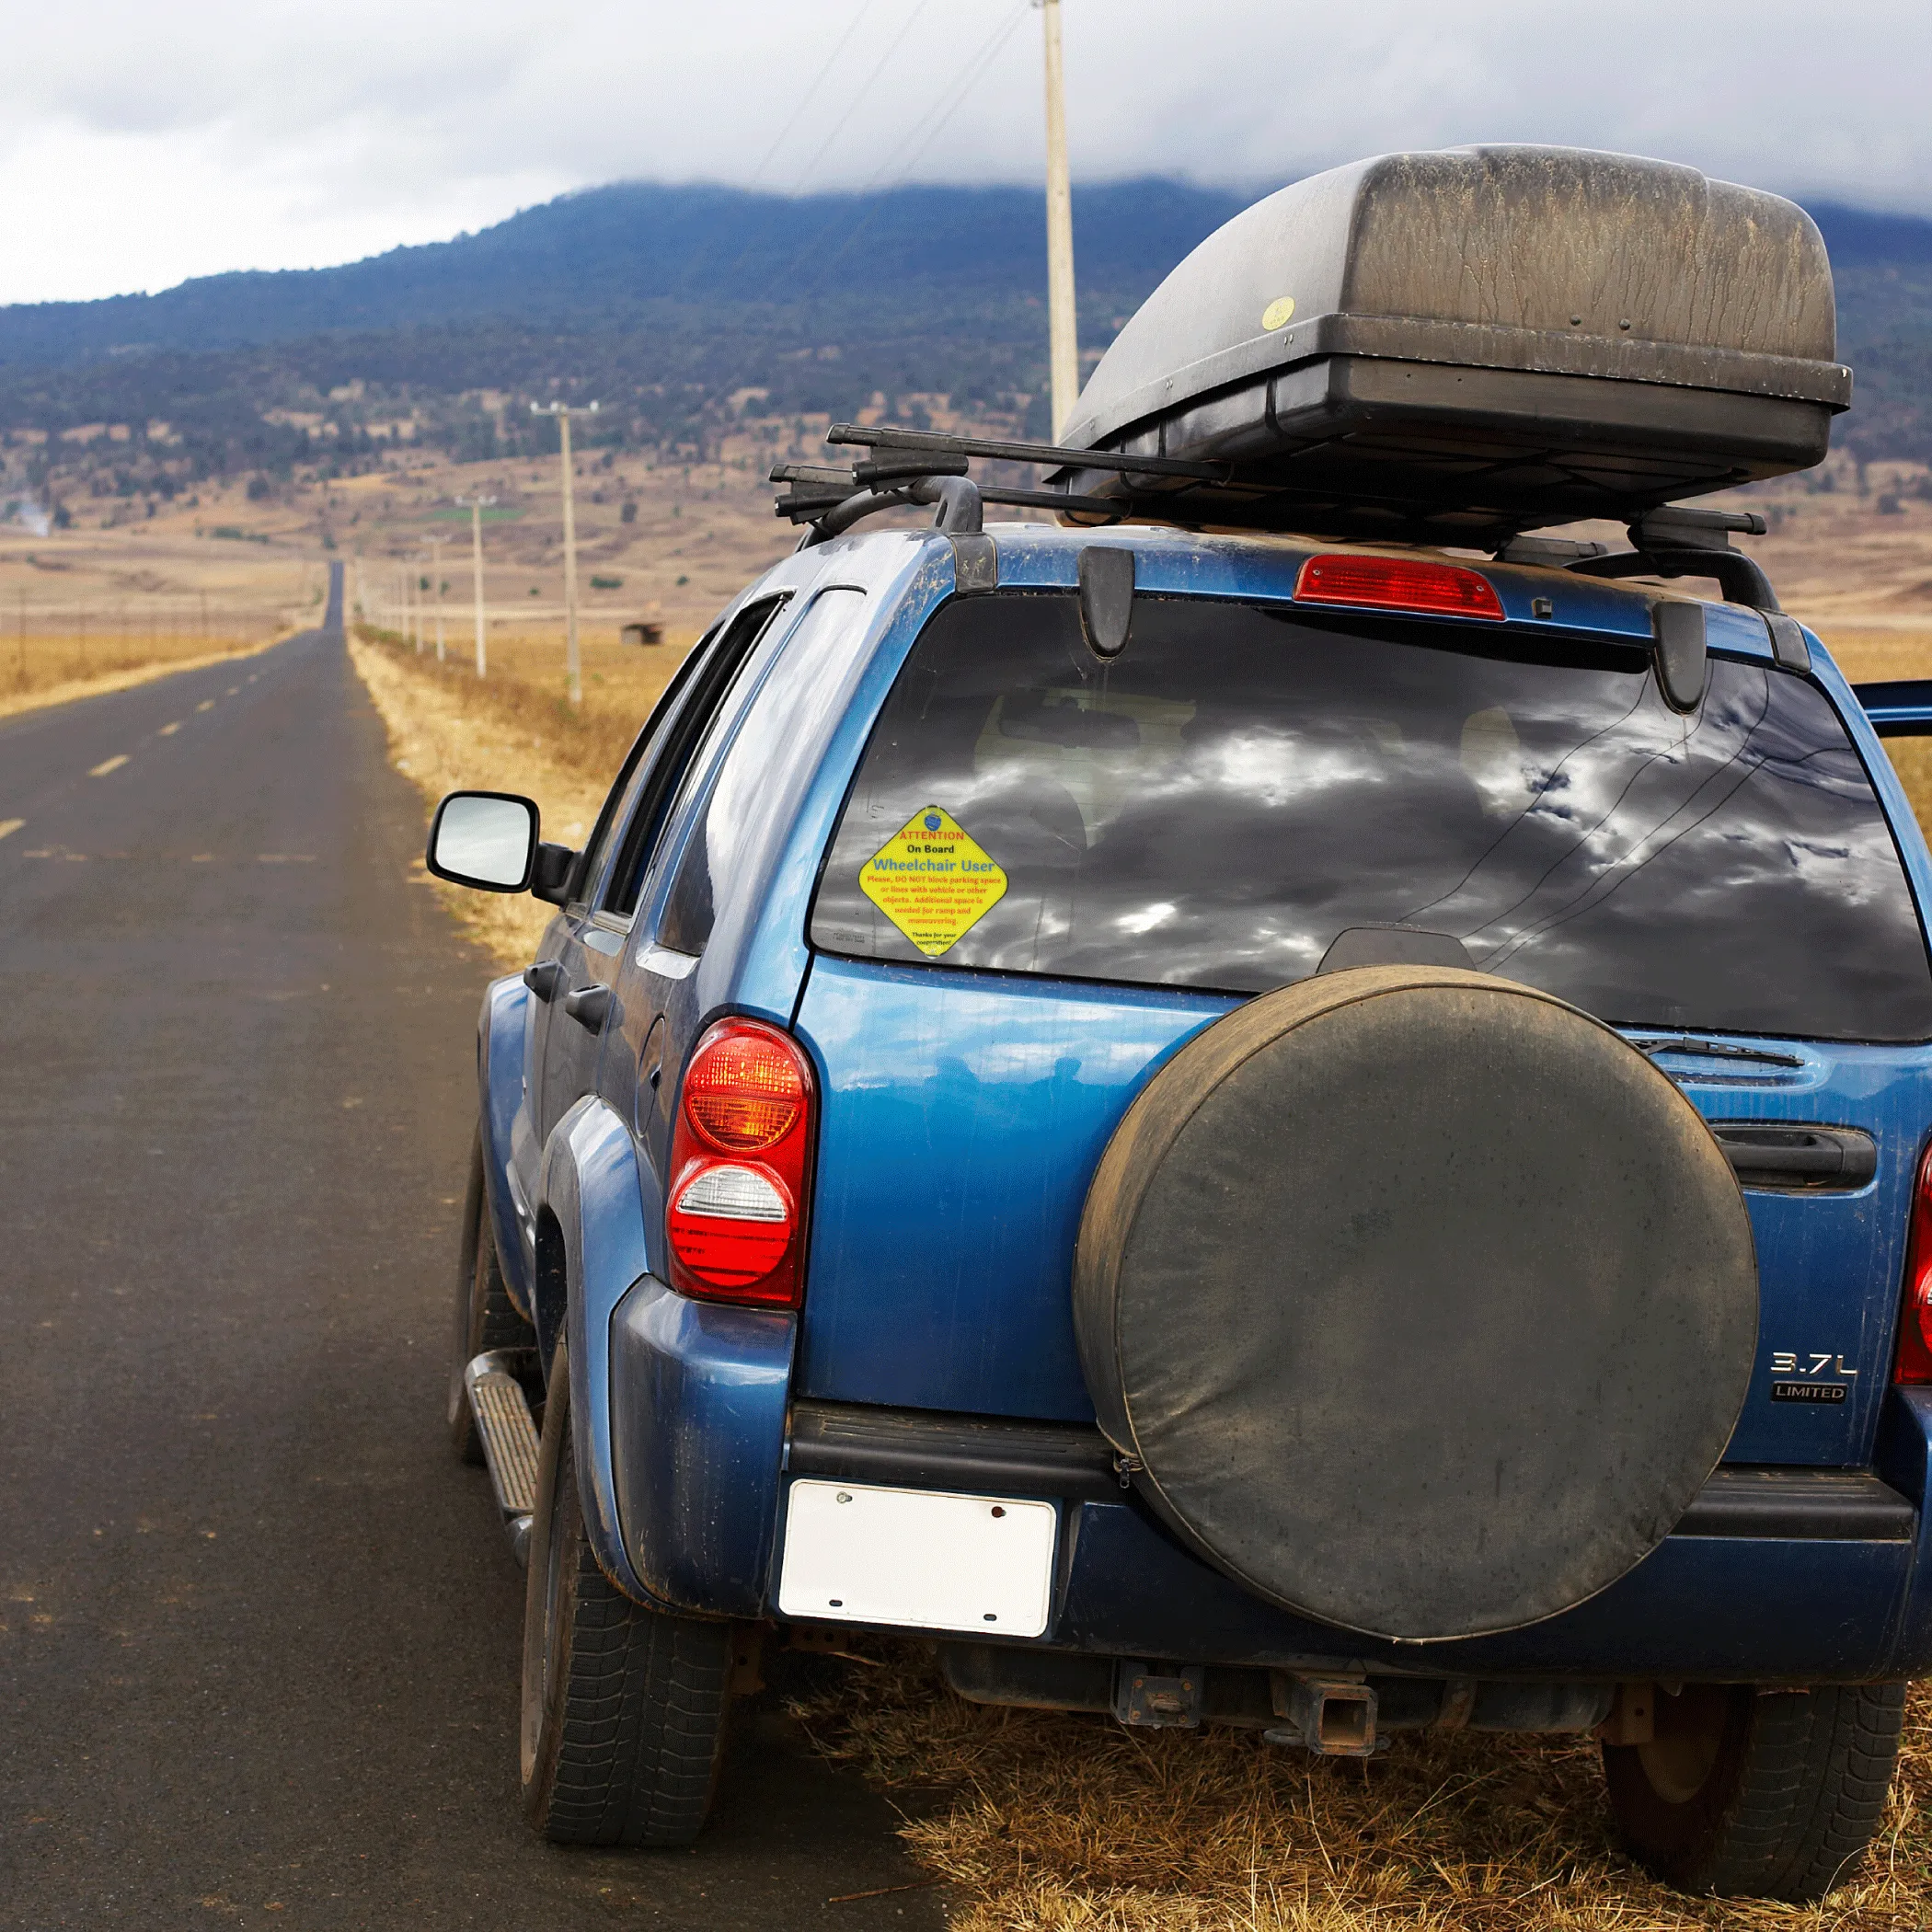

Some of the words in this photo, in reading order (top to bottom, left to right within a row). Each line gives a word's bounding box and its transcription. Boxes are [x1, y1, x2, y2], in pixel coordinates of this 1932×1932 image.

[899, 831, 965, 840] ATTENTION
[907, 845, 922, 854] On
[925, 845, 955, 854] Board
[873, 858, 957, 871] Wheelchair
[961, 859, 995, 872] User
[949, 876, 979, 885] parking
[922, 907, 934, 915] for
[1770, 1351, 1857, 1375] 3.7L
[1776, 1386, 1845, 1398] LIMITED
